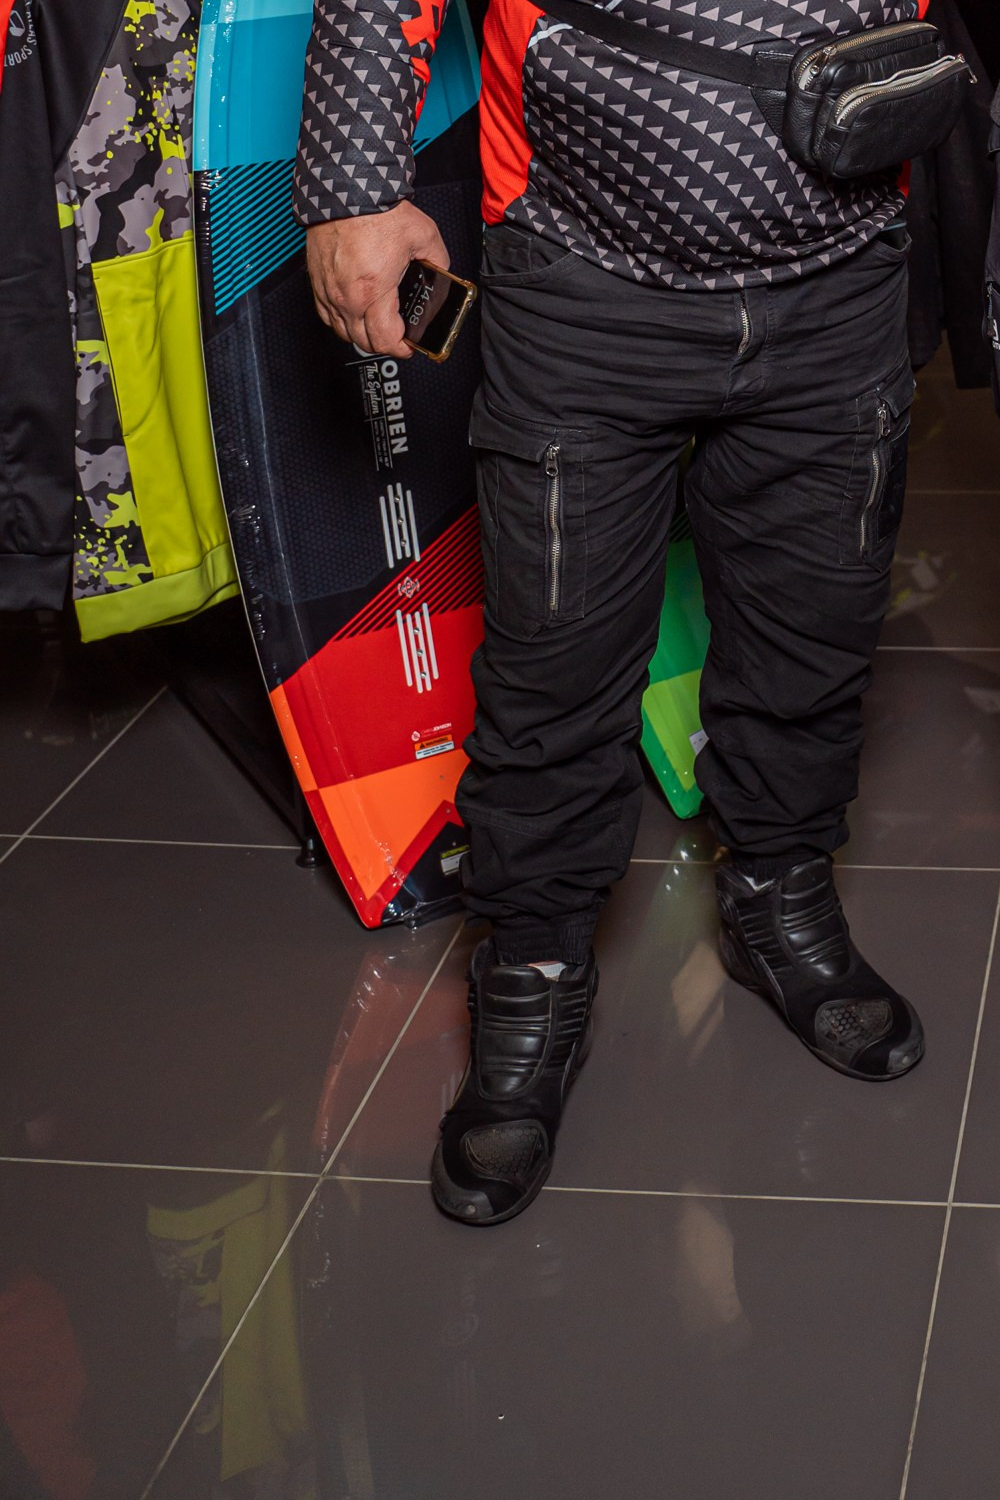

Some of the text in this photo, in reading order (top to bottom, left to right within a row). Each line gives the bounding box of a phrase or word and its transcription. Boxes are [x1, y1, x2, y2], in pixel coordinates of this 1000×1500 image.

[409, 285, 434, 326] 14:08
[365, 361, 379, 380] The
[364, 380, 382, 416] System
[381, 360, 409, 455] OBRIEN
